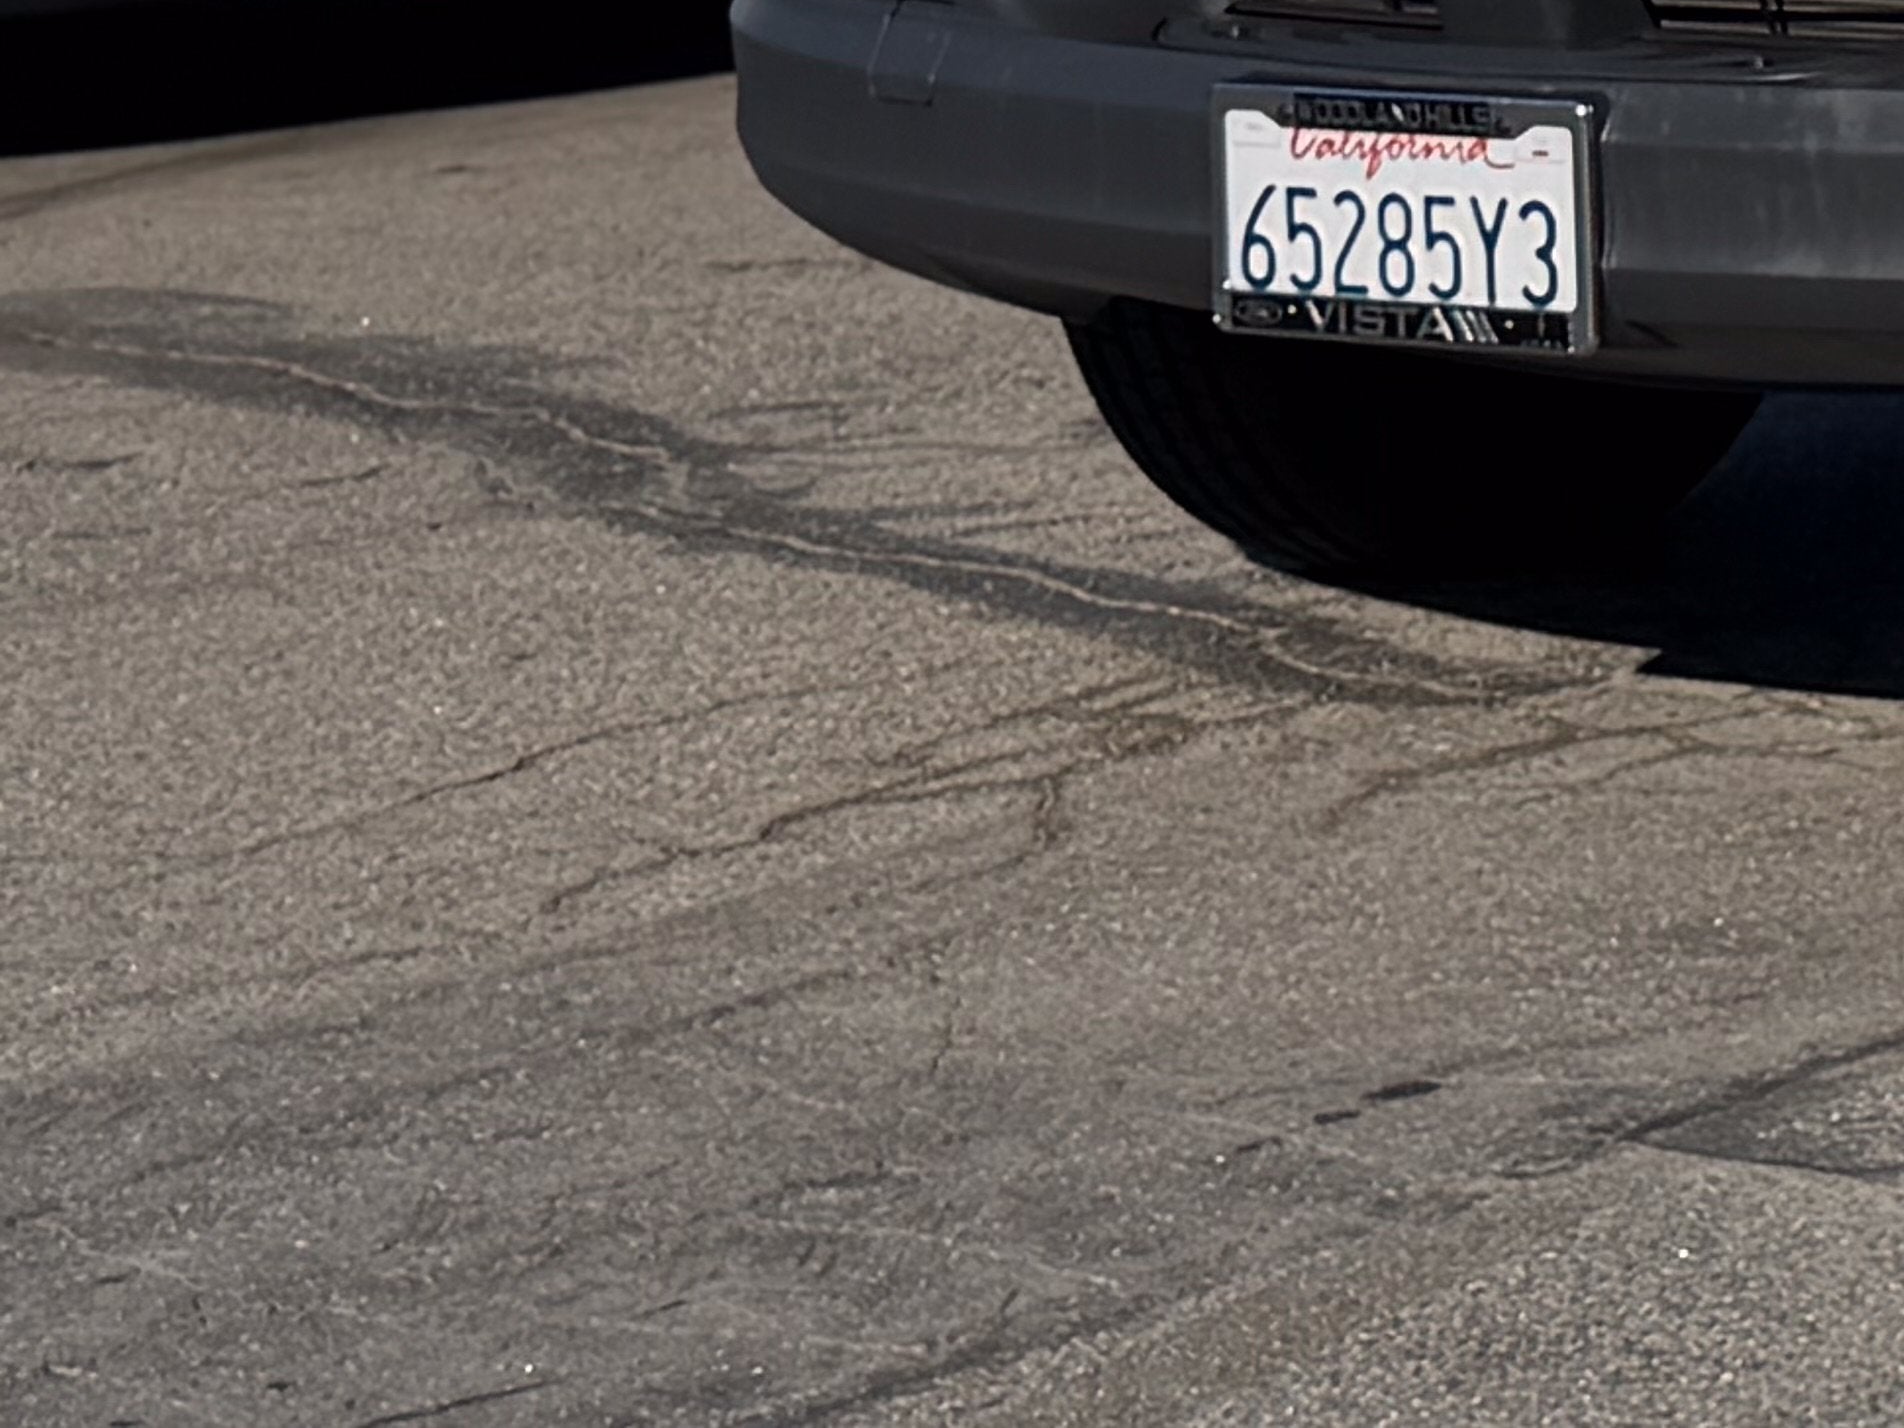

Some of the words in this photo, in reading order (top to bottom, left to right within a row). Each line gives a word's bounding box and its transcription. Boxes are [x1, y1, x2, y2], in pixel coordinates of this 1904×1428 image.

[1290, 127, 1515, 180] California
[1240, 183, 1559, 307] 65285Y3
[1305, 299, 1454, 342] VISTA
